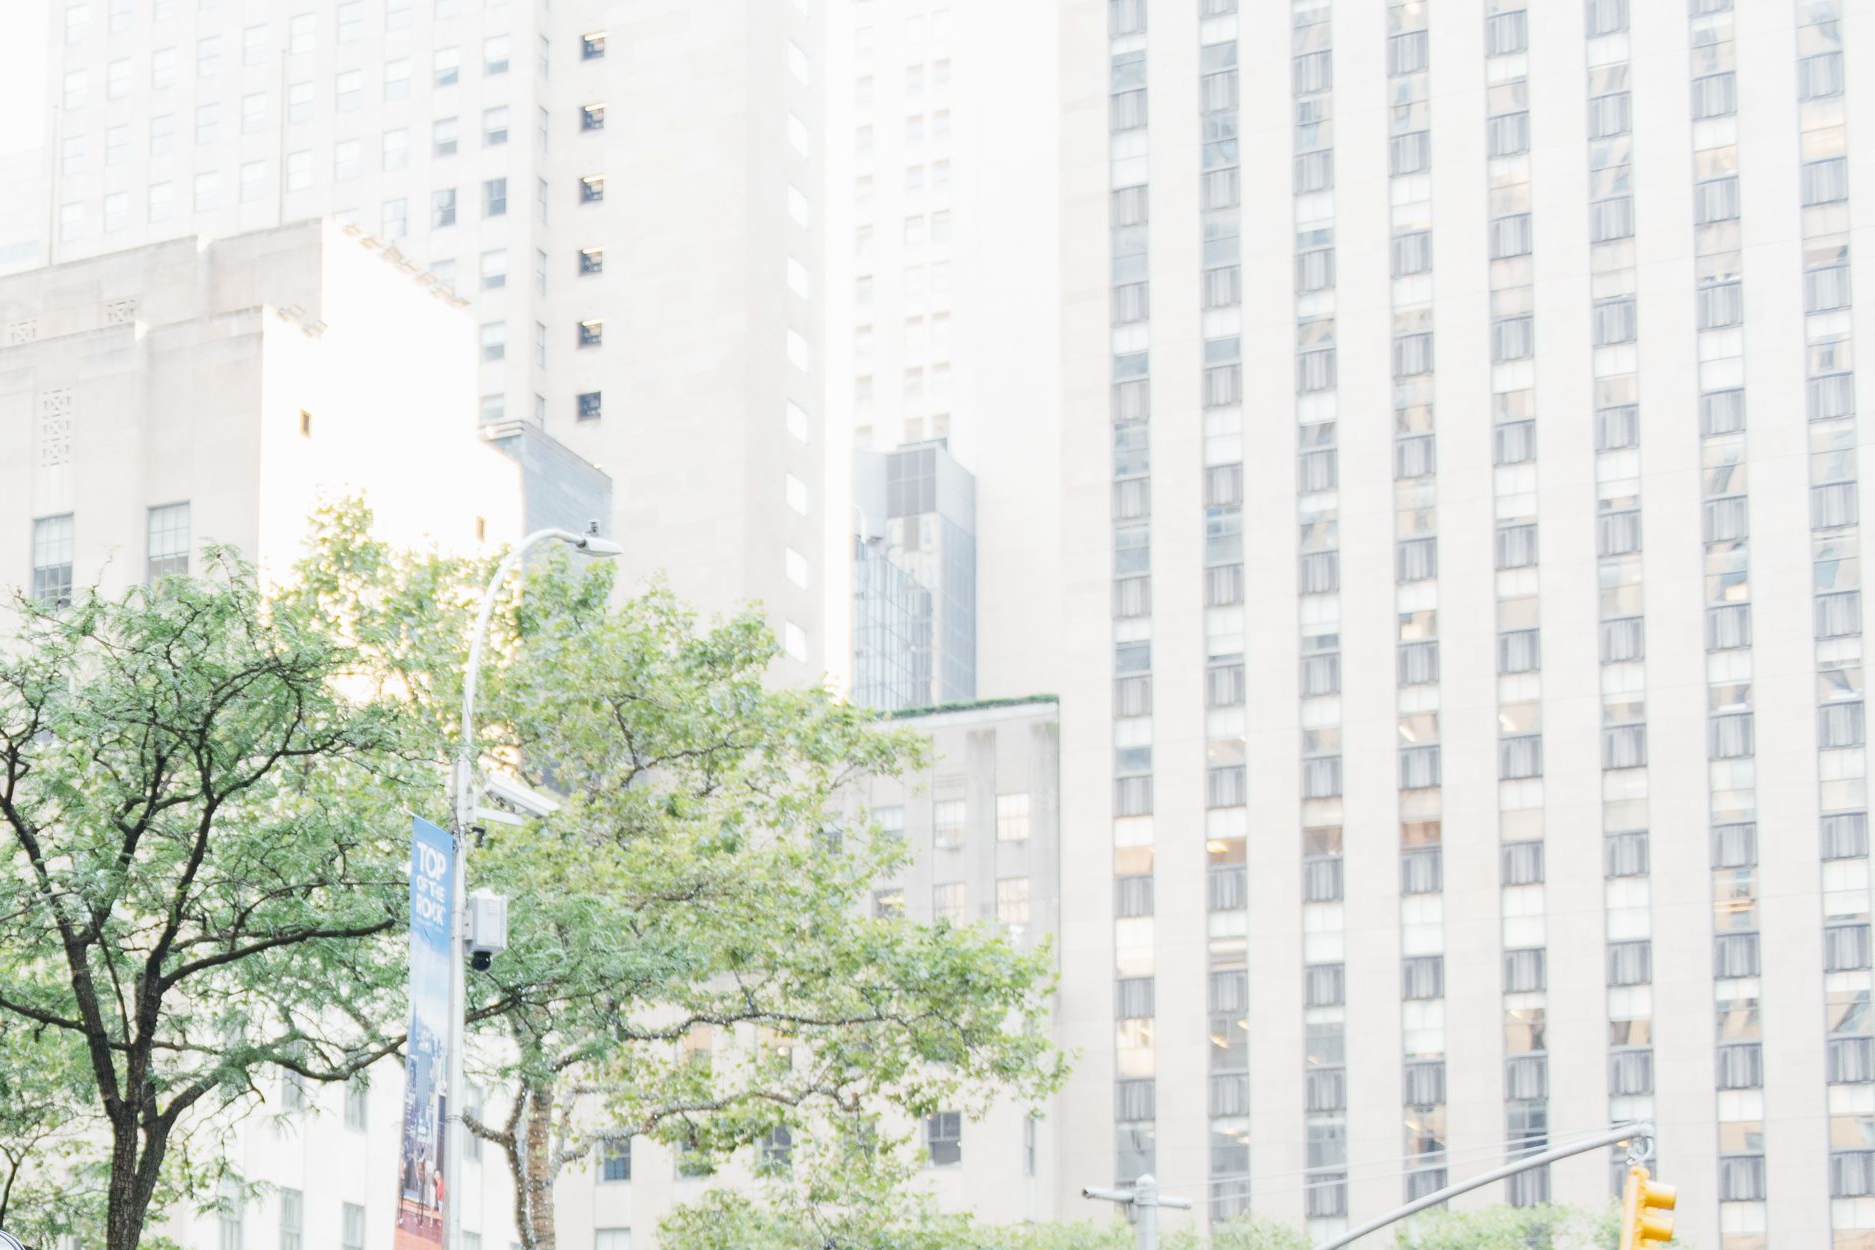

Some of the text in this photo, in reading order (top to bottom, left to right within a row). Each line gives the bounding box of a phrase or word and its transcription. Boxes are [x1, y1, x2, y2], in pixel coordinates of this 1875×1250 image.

[416, 841, 446, 880] TOP
[416, 875, 445, 903] OF THE
[416, 893, 446, 926] ROCK
